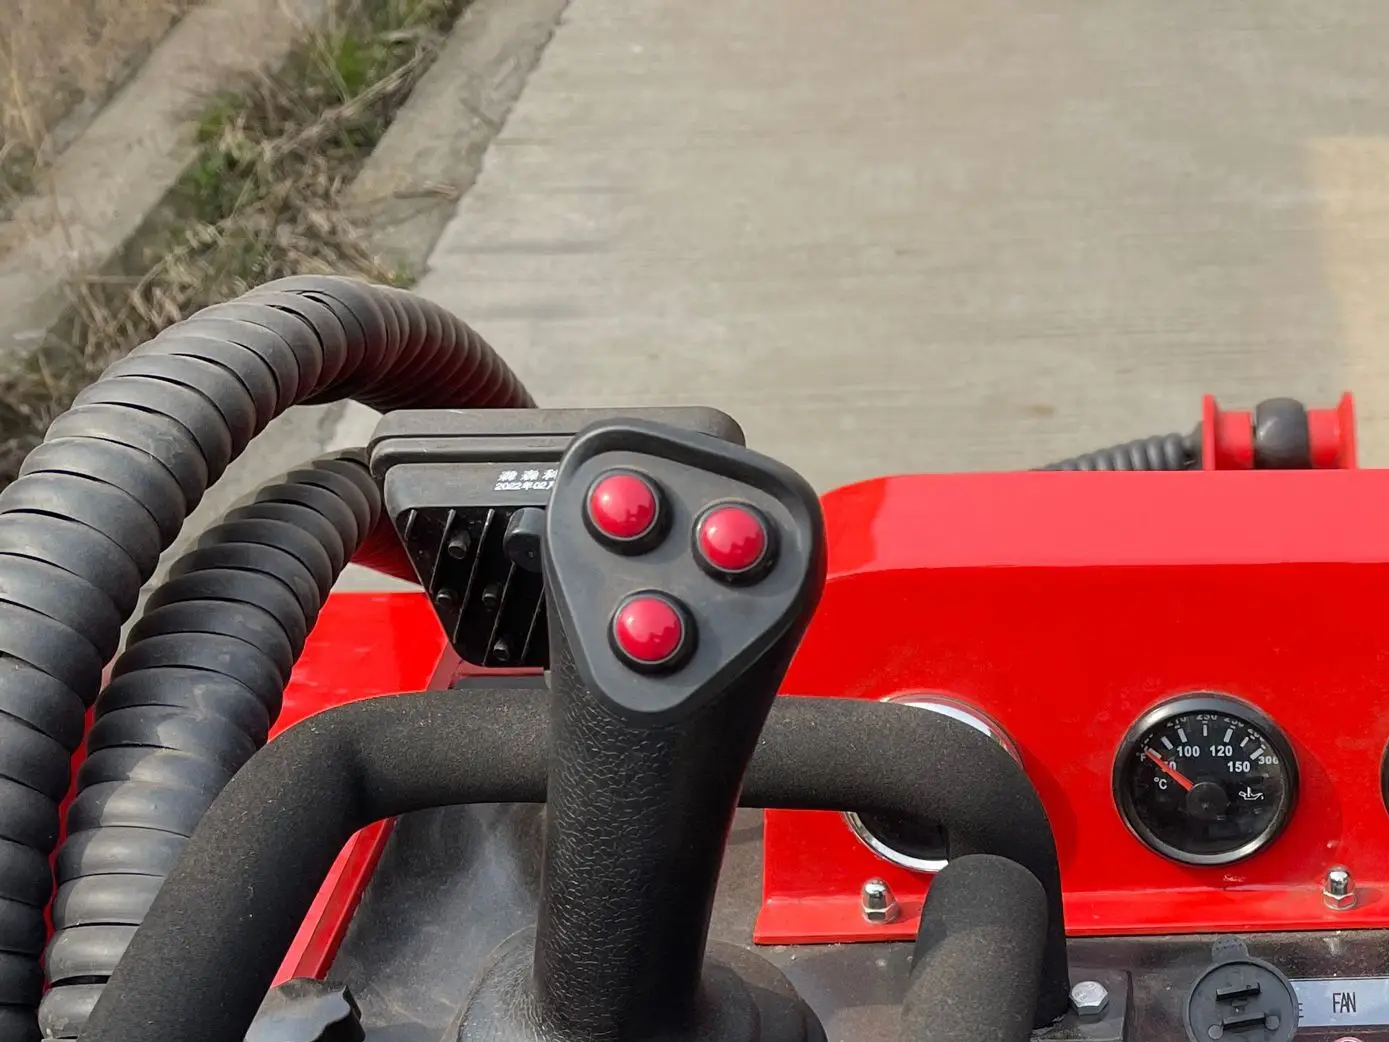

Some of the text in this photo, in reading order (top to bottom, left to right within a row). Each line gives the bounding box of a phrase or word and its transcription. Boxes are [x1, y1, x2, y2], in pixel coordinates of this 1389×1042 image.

[1176, 745, 1200, 757] 100
[1209, 745, 1233, 757] 120
[1227, 761, 1250, 772] 150
[1258, 756, 1279, 765] 300
[1332, 992, 1356, 1013] FAN
